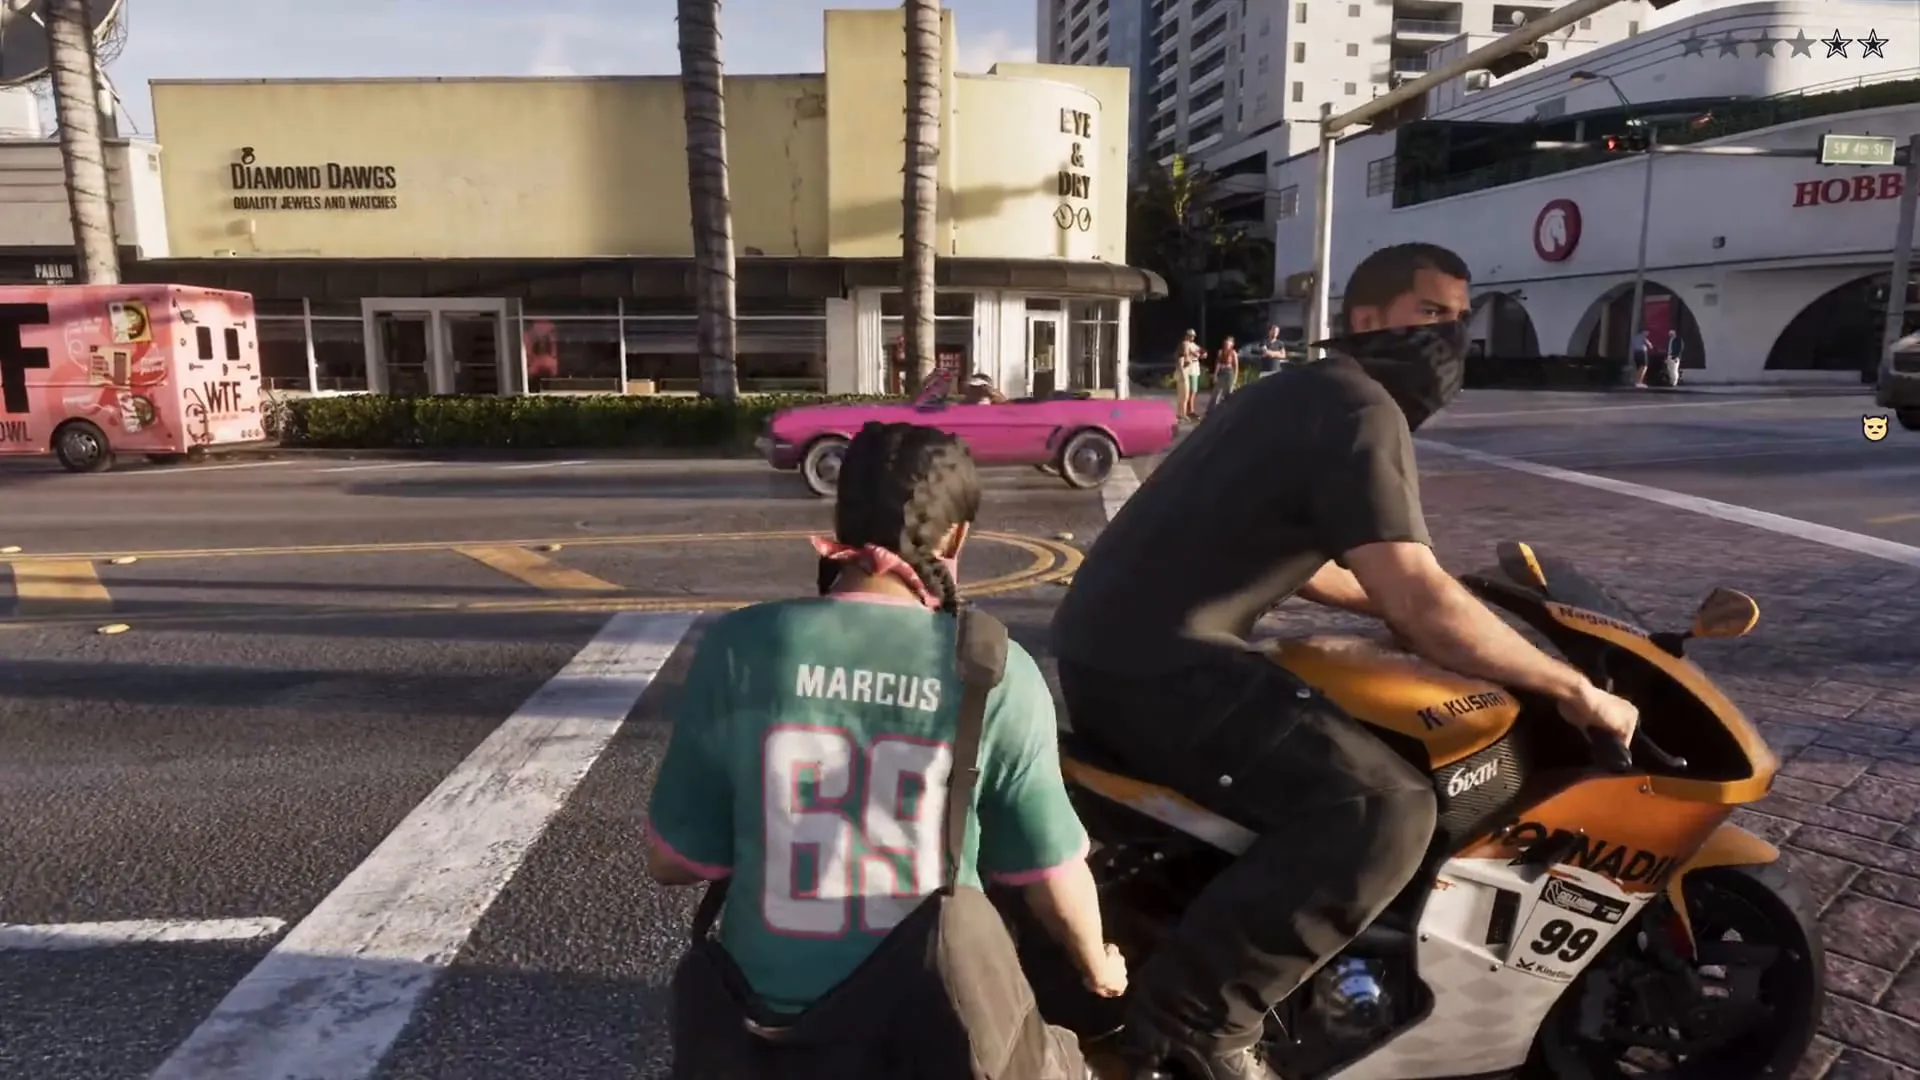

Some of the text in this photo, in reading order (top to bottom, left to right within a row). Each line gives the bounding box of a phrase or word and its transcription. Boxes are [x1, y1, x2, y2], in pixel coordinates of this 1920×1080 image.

[1060, 107, 1091, 139] EYE
[1070, 141, 1085, 168] &
[230, 162, 397, 190] DIAMOND DAWGS
[1058, 171, 1091, 199] DRY
[233, 195, 398, 210] QUALITY JEWELS AND WATCHES
[203, 381, 242, 414] WTF
[796, 663, 942, 712] MARCUS
[763, 722, 953, 940] 69
[1530, 918, 1599, 963] 99
